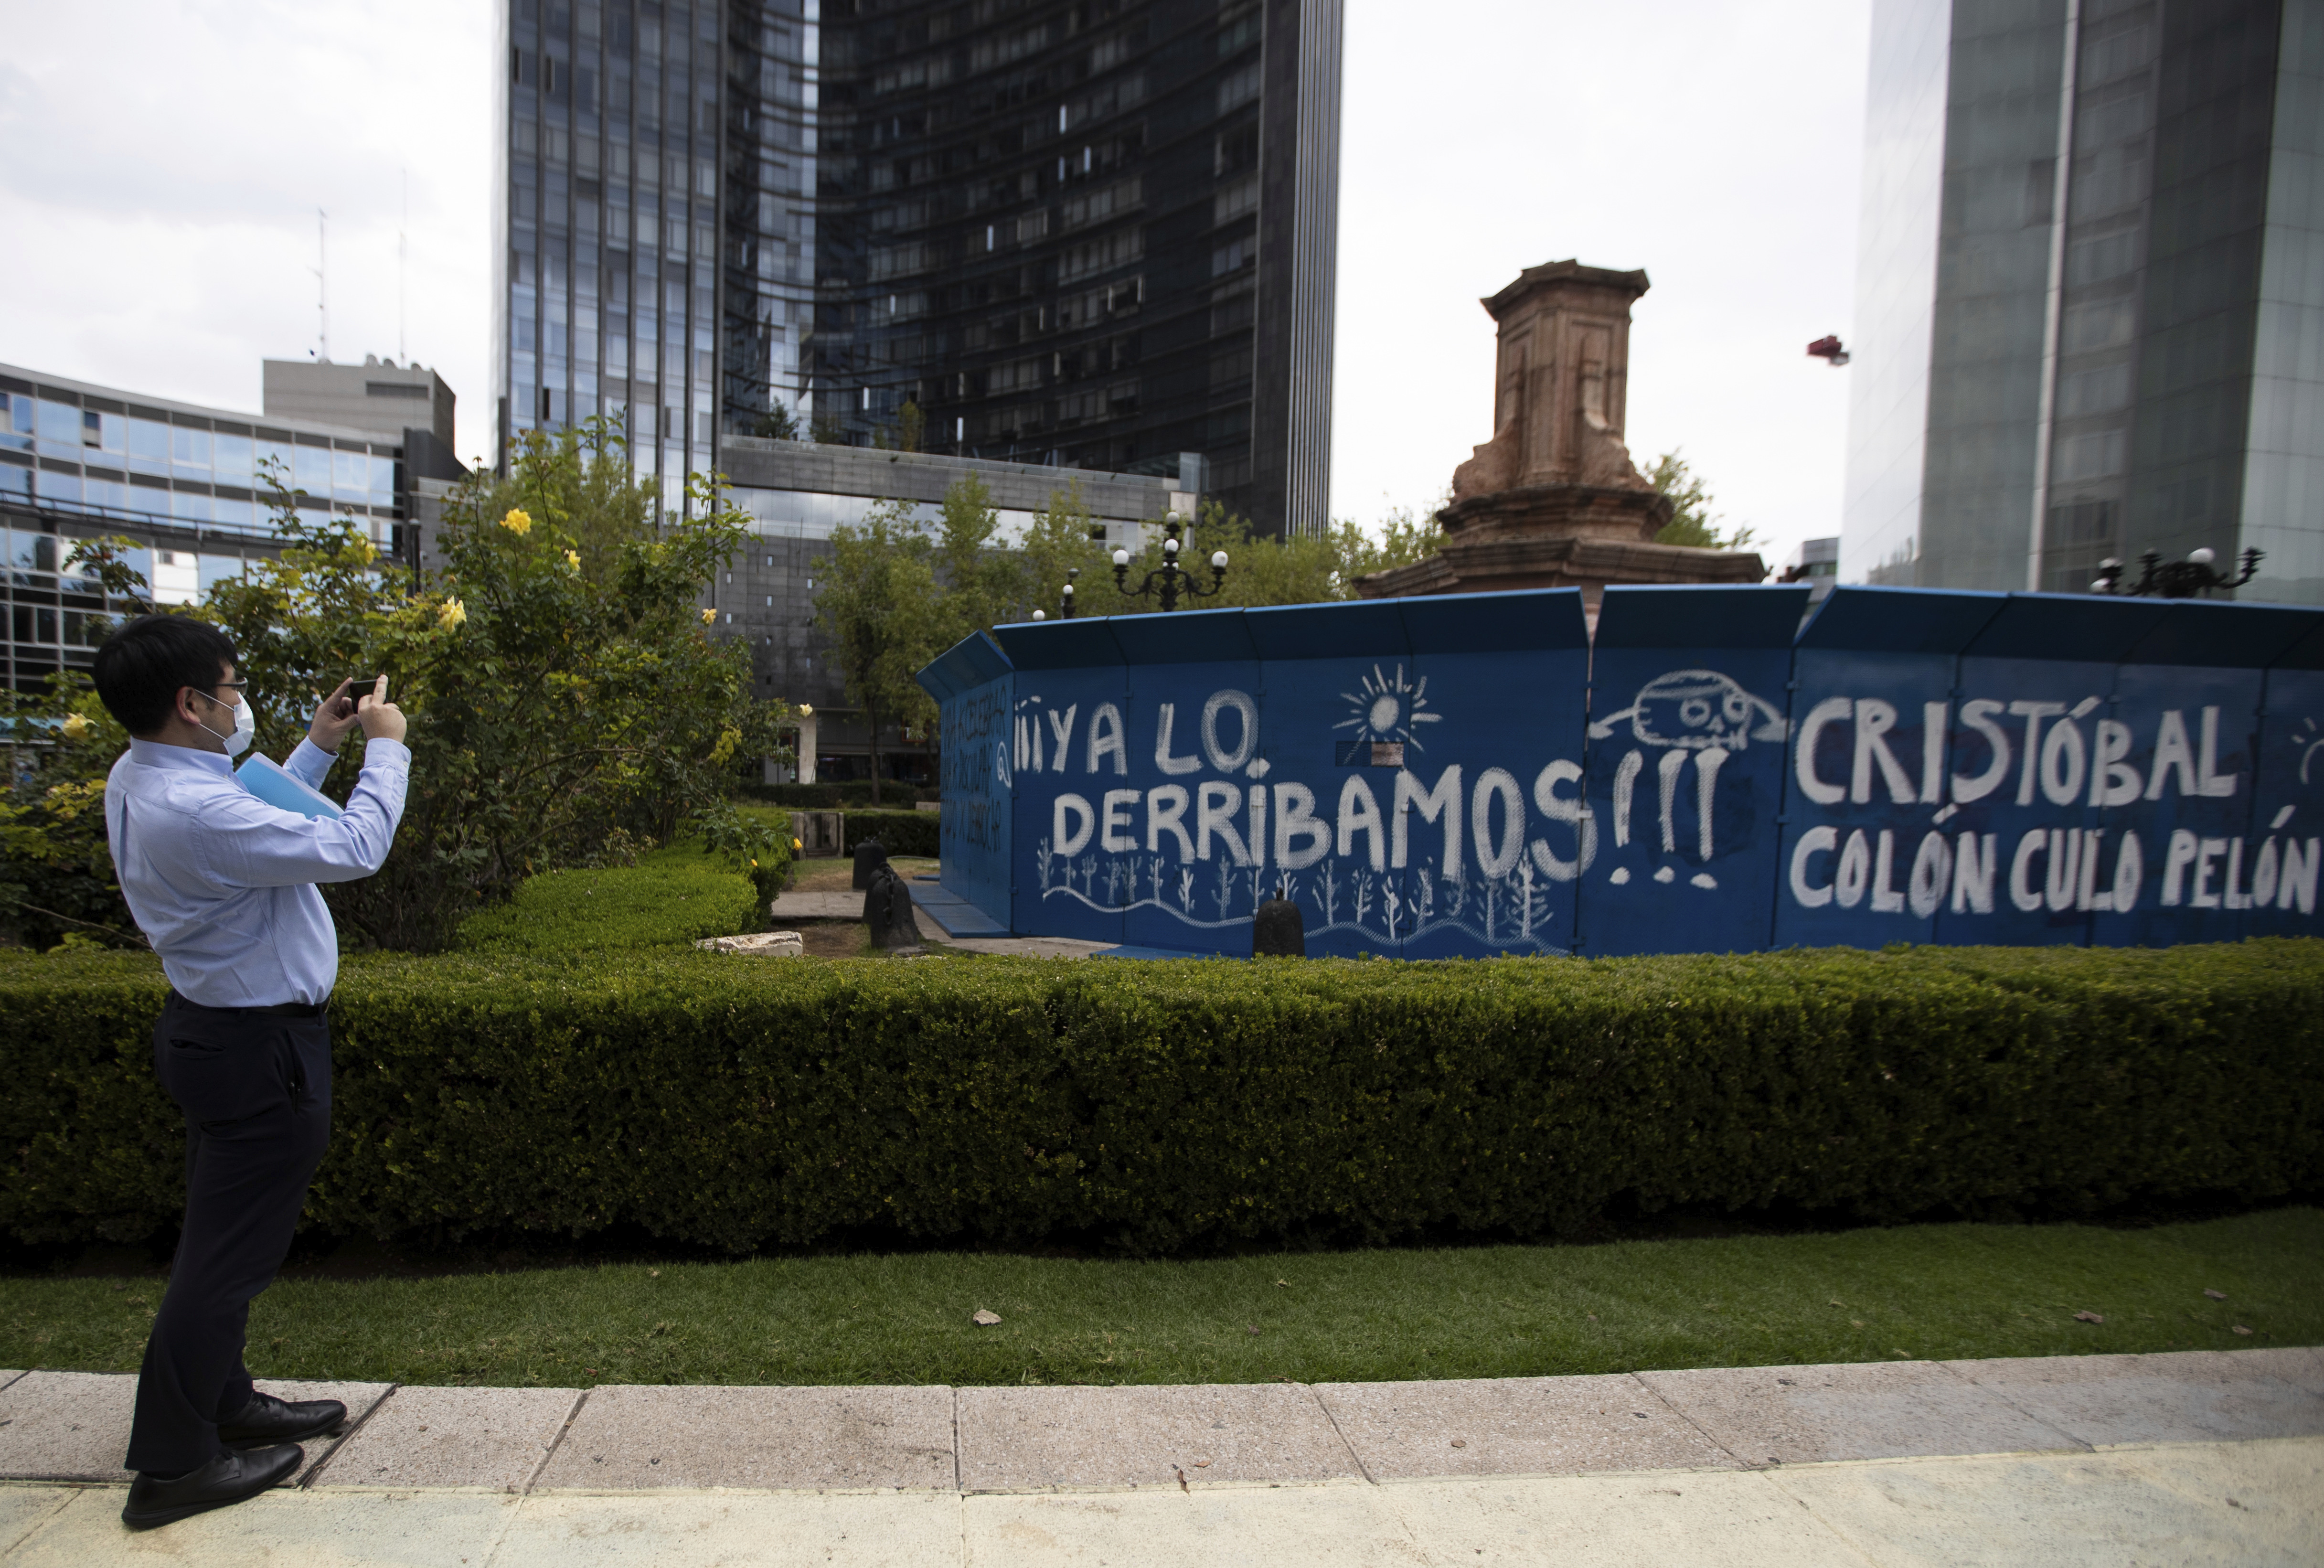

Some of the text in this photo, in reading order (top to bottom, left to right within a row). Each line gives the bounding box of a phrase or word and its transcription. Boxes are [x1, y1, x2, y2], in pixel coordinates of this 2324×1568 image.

[1155, 689, 1259, 775] LO
[1795, 696, 2237, 807] CRISTÓBAL
[1790, 804, 2322, 919] COLÓN CULO PELÓN
